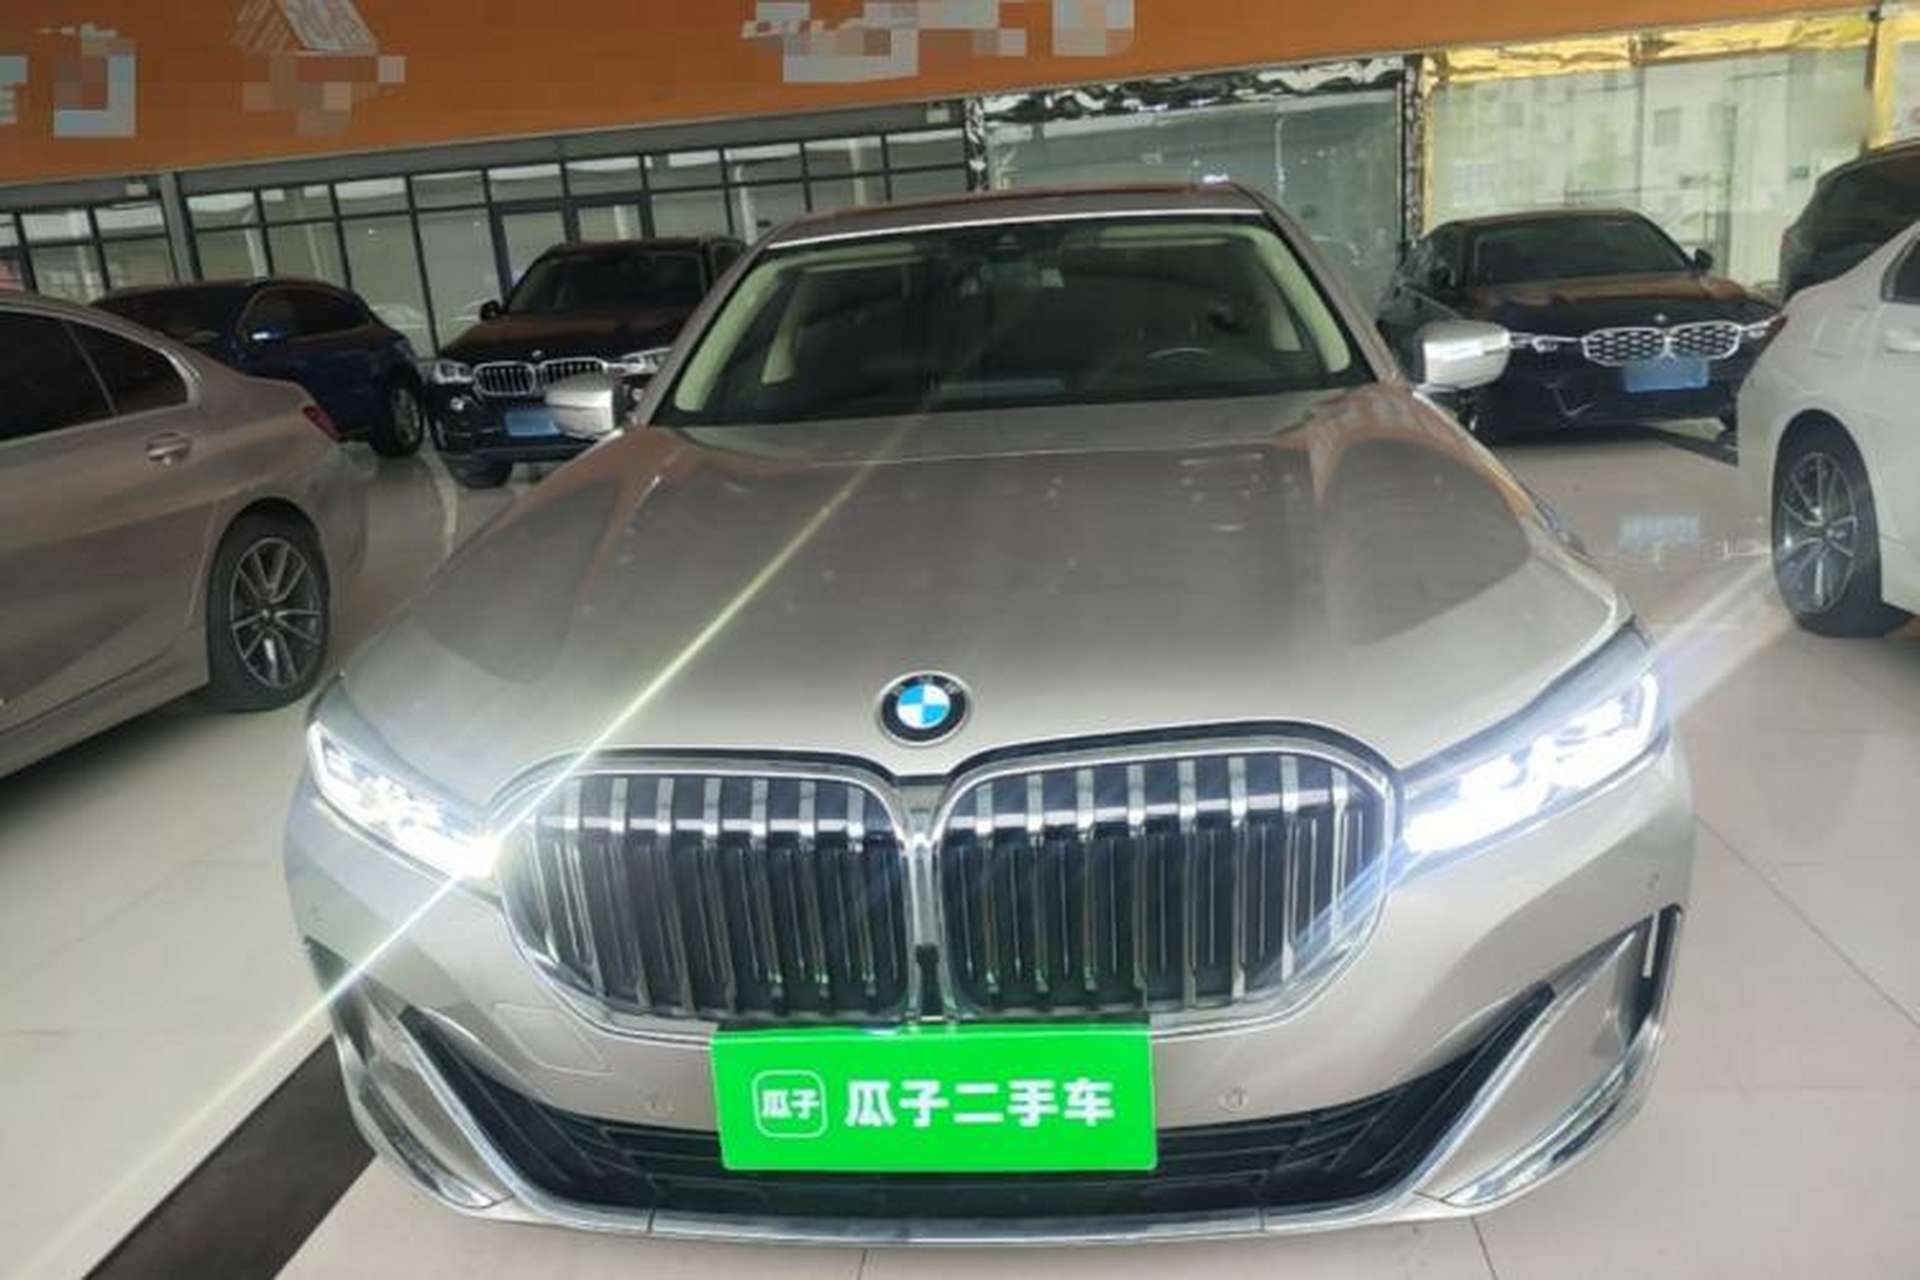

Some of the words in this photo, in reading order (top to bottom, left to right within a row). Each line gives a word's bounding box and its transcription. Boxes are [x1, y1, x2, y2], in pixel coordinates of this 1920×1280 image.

[760, 1088, 820, 1119] 瓜子
[844, 1078, 1116, 1127] 瓜子二手车
